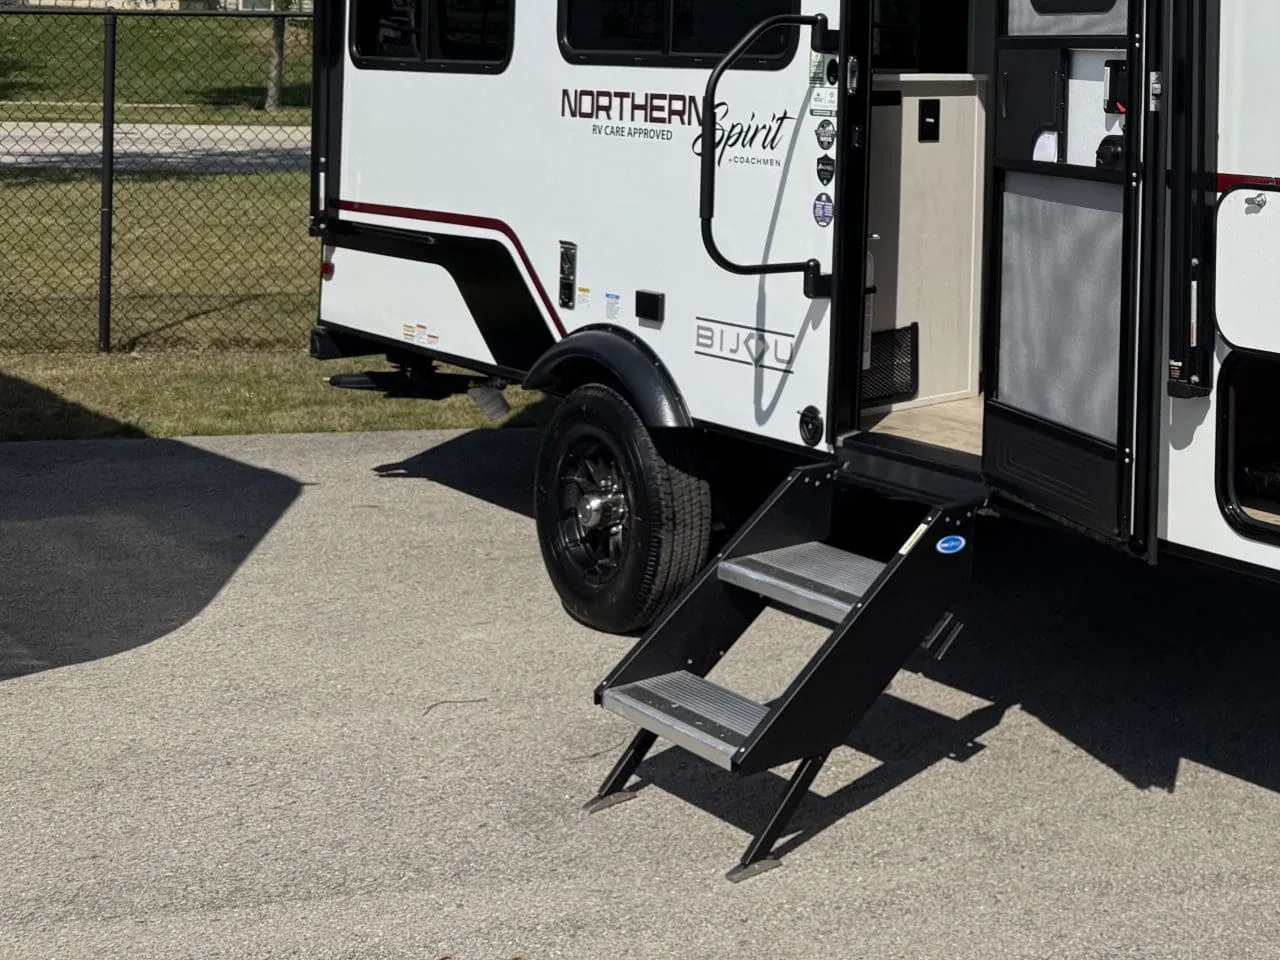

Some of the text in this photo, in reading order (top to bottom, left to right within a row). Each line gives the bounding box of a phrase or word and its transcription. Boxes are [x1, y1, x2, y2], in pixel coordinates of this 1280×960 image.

[561, 89, 703, 127] NORTHERN
[592, 124, 673, 141] RV CARE APPROVED
[734, 156, 781, 167] COACHMEN
